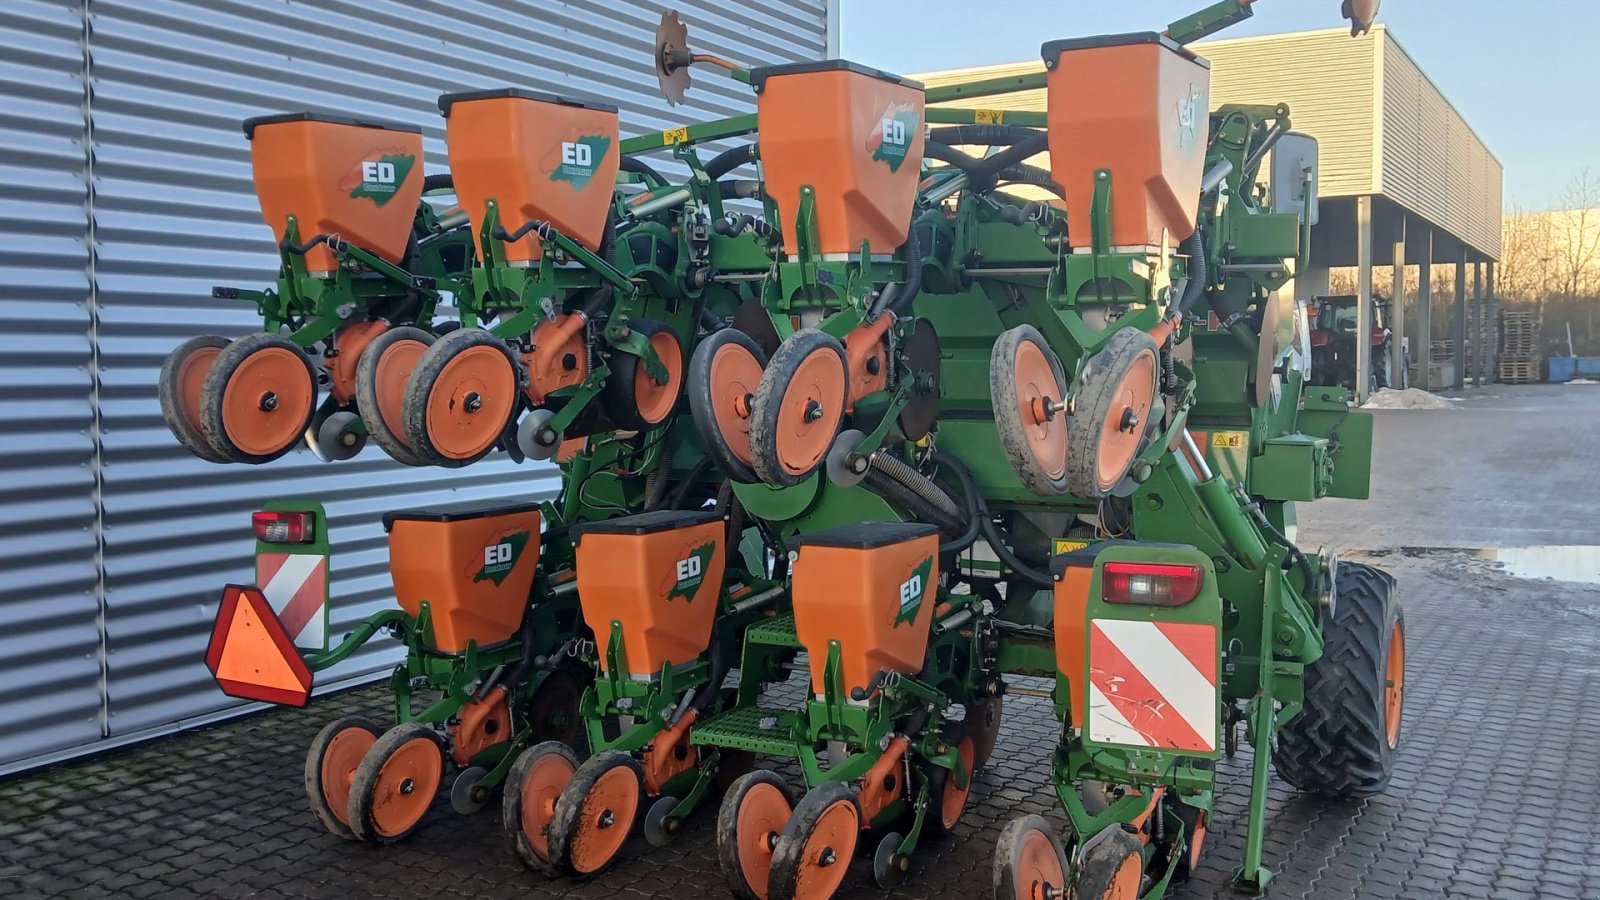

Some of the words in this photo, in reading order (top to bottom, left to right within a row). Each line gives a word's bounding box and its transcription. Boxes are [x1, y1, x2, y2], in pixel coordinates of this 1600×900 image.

[882, 118, 905, 145] ED
[562, 142, 592, 166] ED
[362, 161, 396, 183] ED
[485, 543, 512, 565] ED
[677, 555, 701, 581] ED
[900, 574, 921, 606] ED
